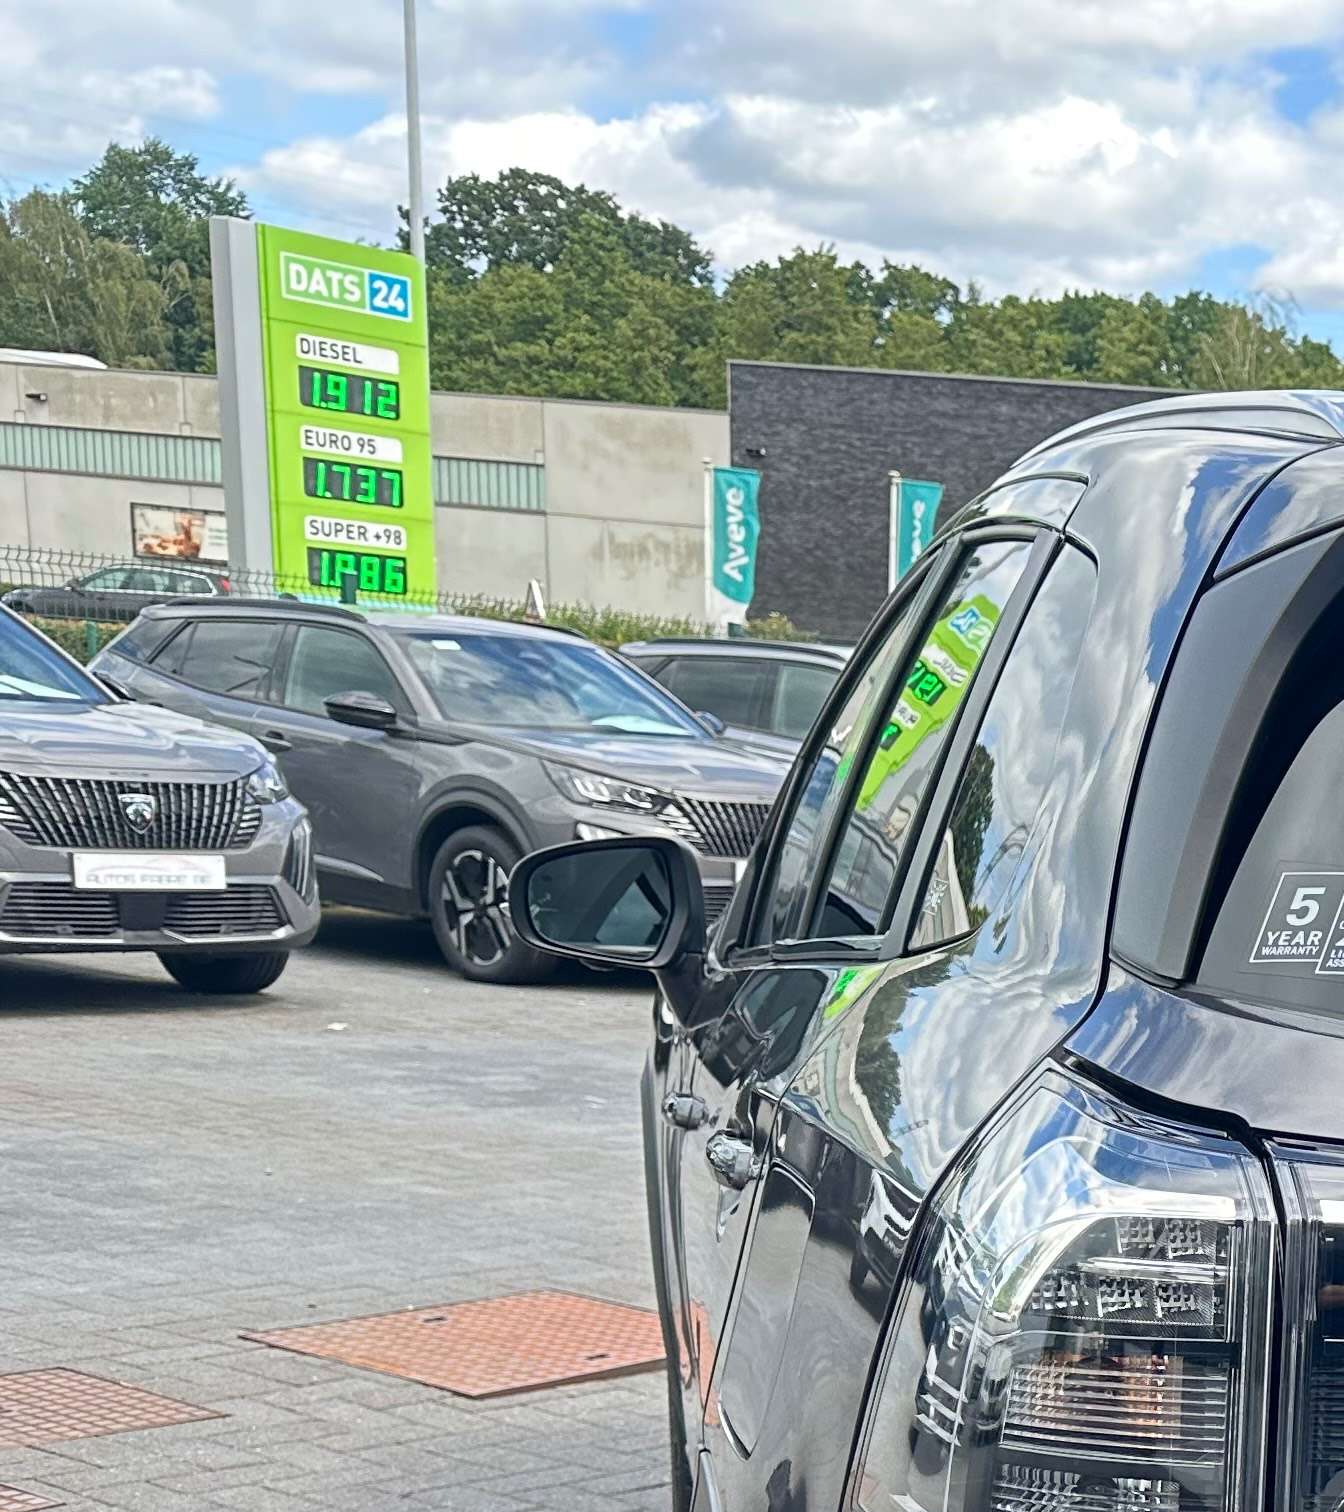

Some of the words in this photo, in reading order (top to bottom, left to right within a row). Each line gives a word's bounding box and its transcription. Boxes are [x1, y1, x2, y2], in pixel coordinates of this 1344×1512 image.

[288, 261, 362, 304] DATS
[370, 279, 407, 314] 24
[299, 336, 363, 366] DIESEL
[303, 428, 352, 452] EURO
[355, 432, 377, 455] 95
[315, 462, 400, 508] 1.737
[308, 518, 369, 543] SUPER
[373, 524, 403, 547] +98
[722, 486, 751, 583] Aveve
[1285, 886, 1327, 927] 5
[1261, 945, 1320, 956] WARRANTY
[1266, 930, 1323, 946] YEAR
